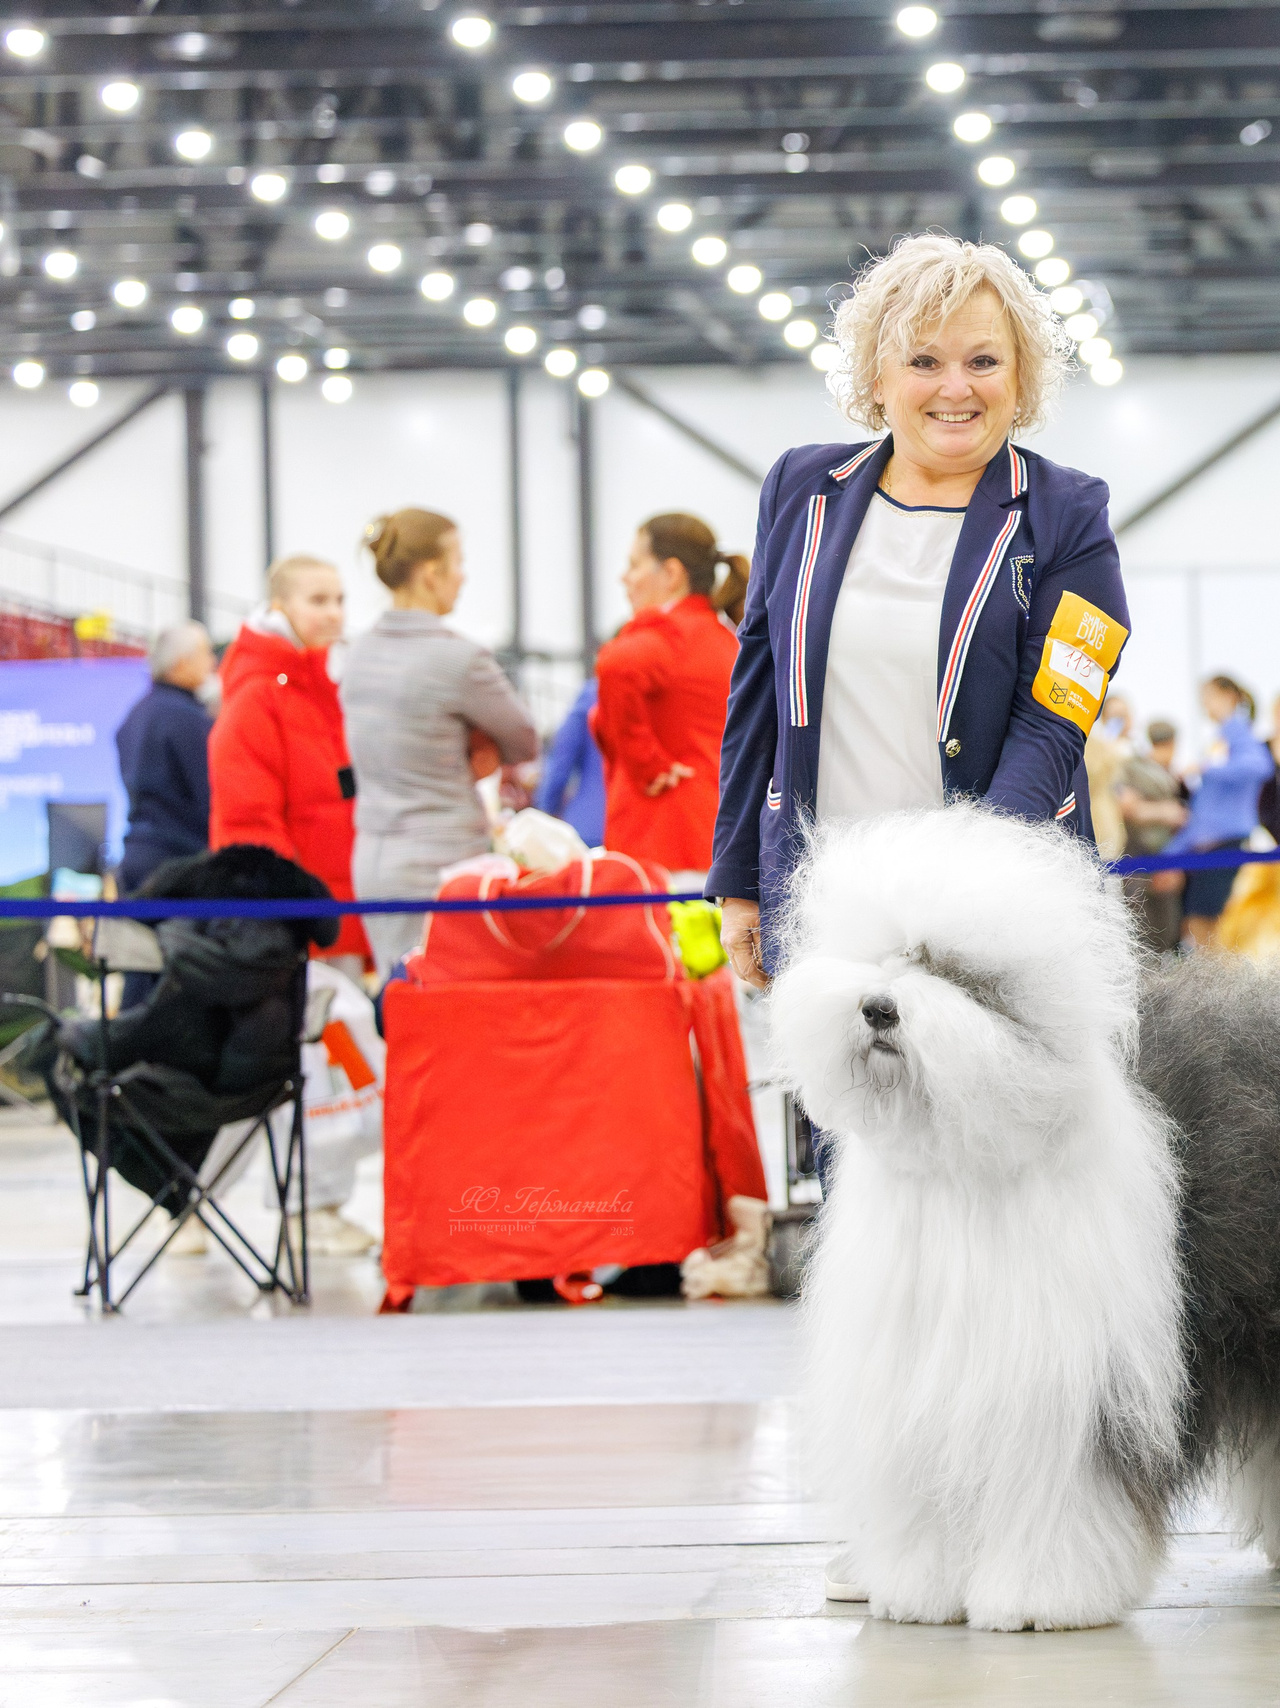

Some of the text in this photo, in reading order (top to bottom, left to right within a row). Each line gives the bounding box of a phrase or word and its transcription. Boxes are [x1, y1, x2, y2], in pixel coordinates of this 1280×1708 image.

[1082, 611, 1108, 635] SMART
[1064, 650, 1092, 678] 113
[1068, 696, 1090, 715] PRODUCT
